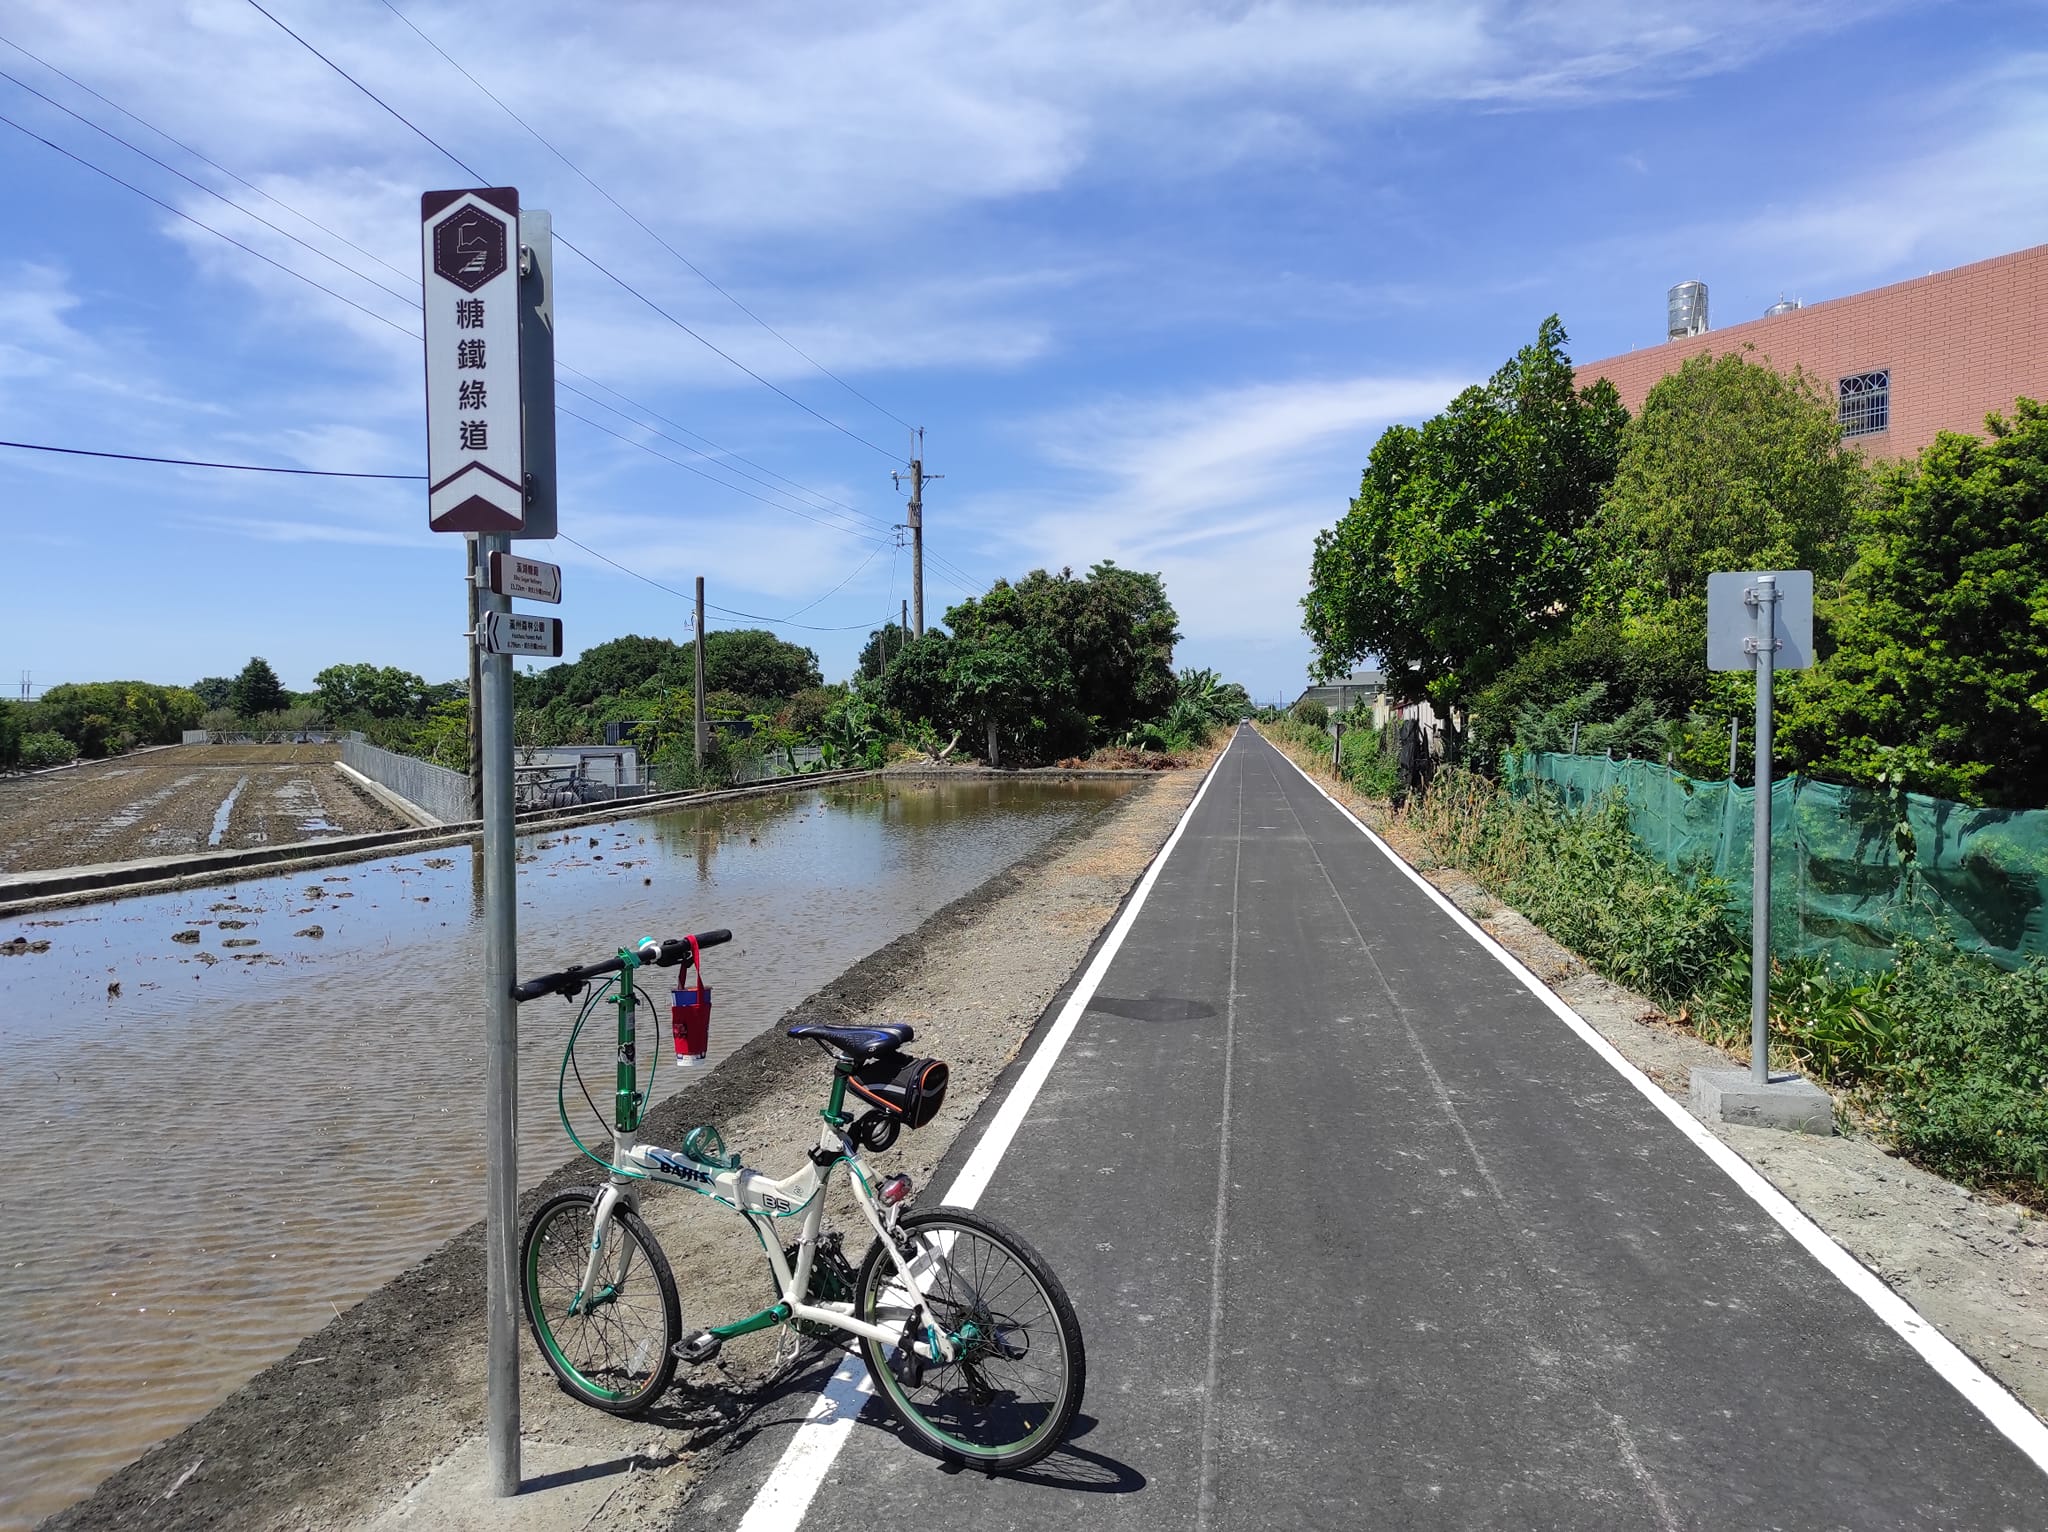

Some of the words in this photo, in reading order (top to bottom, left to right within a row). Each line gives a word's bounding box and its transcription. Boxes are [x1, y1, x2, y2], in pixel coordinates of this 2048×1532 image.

[456, 298, 488, 451] 糖鐵綠道
[762, 1193, 791, 1214] B5
